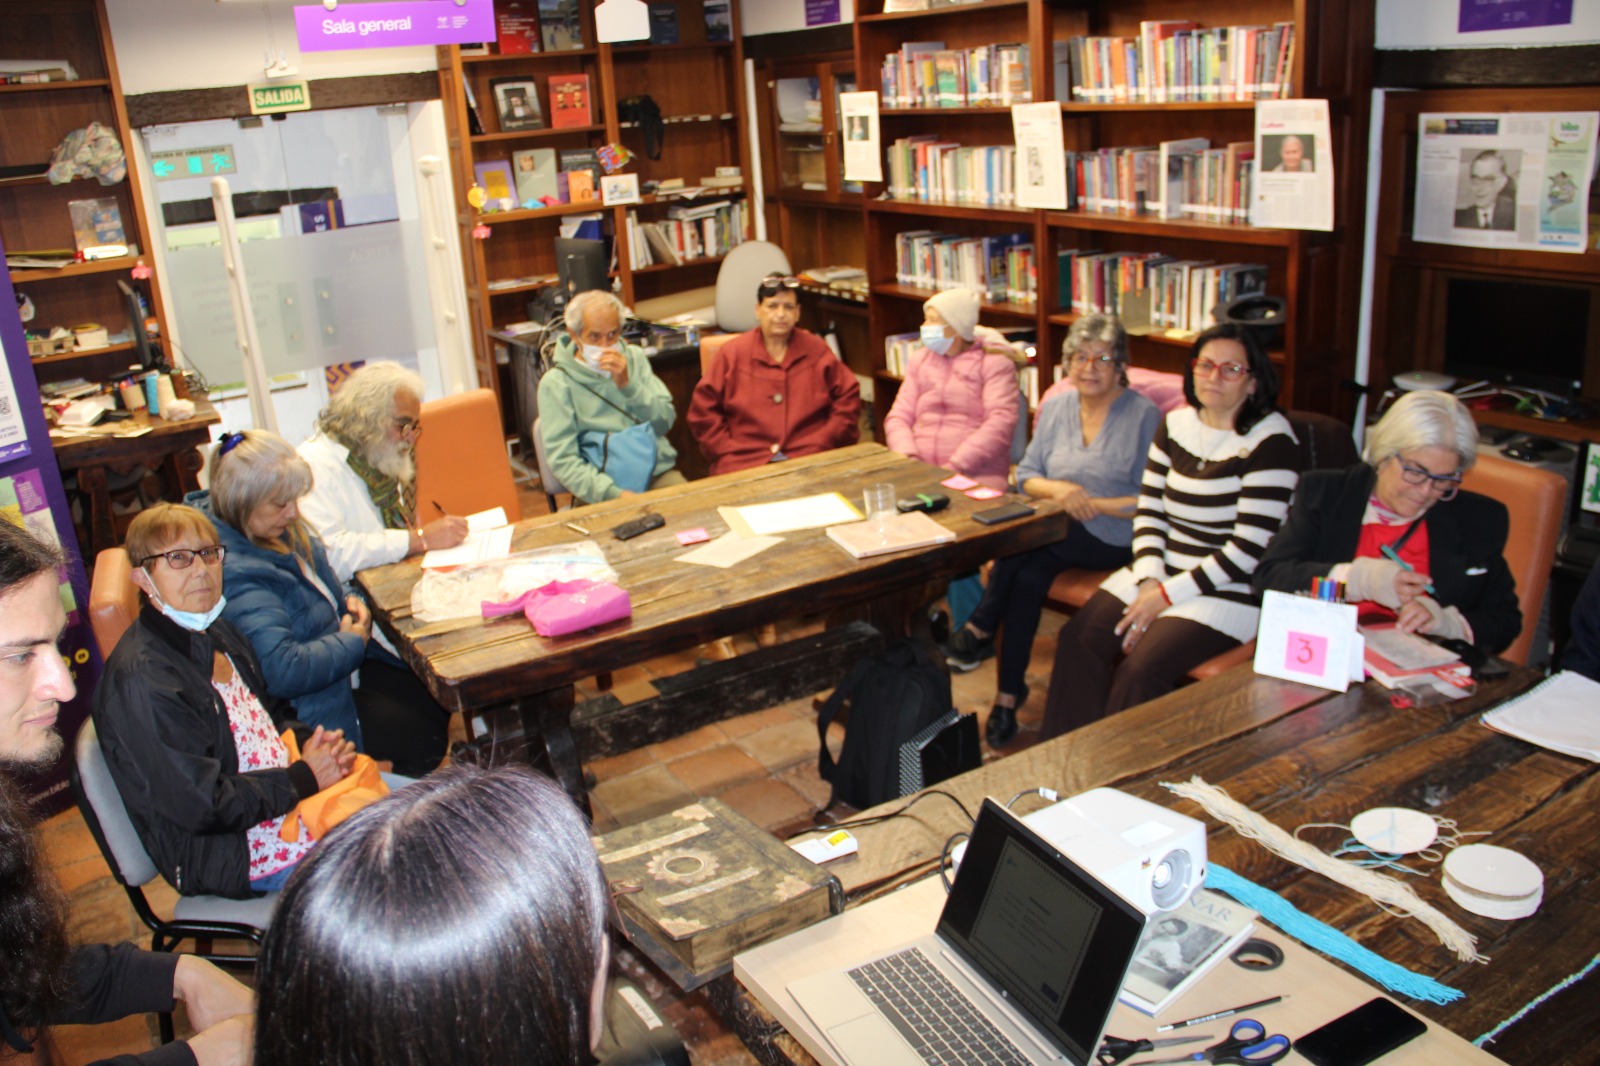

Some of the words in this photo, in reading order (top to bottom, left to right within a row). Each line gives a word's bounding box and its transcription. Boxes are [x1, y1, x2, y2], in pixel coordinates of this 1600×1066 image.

[322, 19, 356, 35] Sala
[358, 16, 412, 36] general
[255, 87, 303, 106] SALIDA
[1297, 638, 1314, 664] 3
